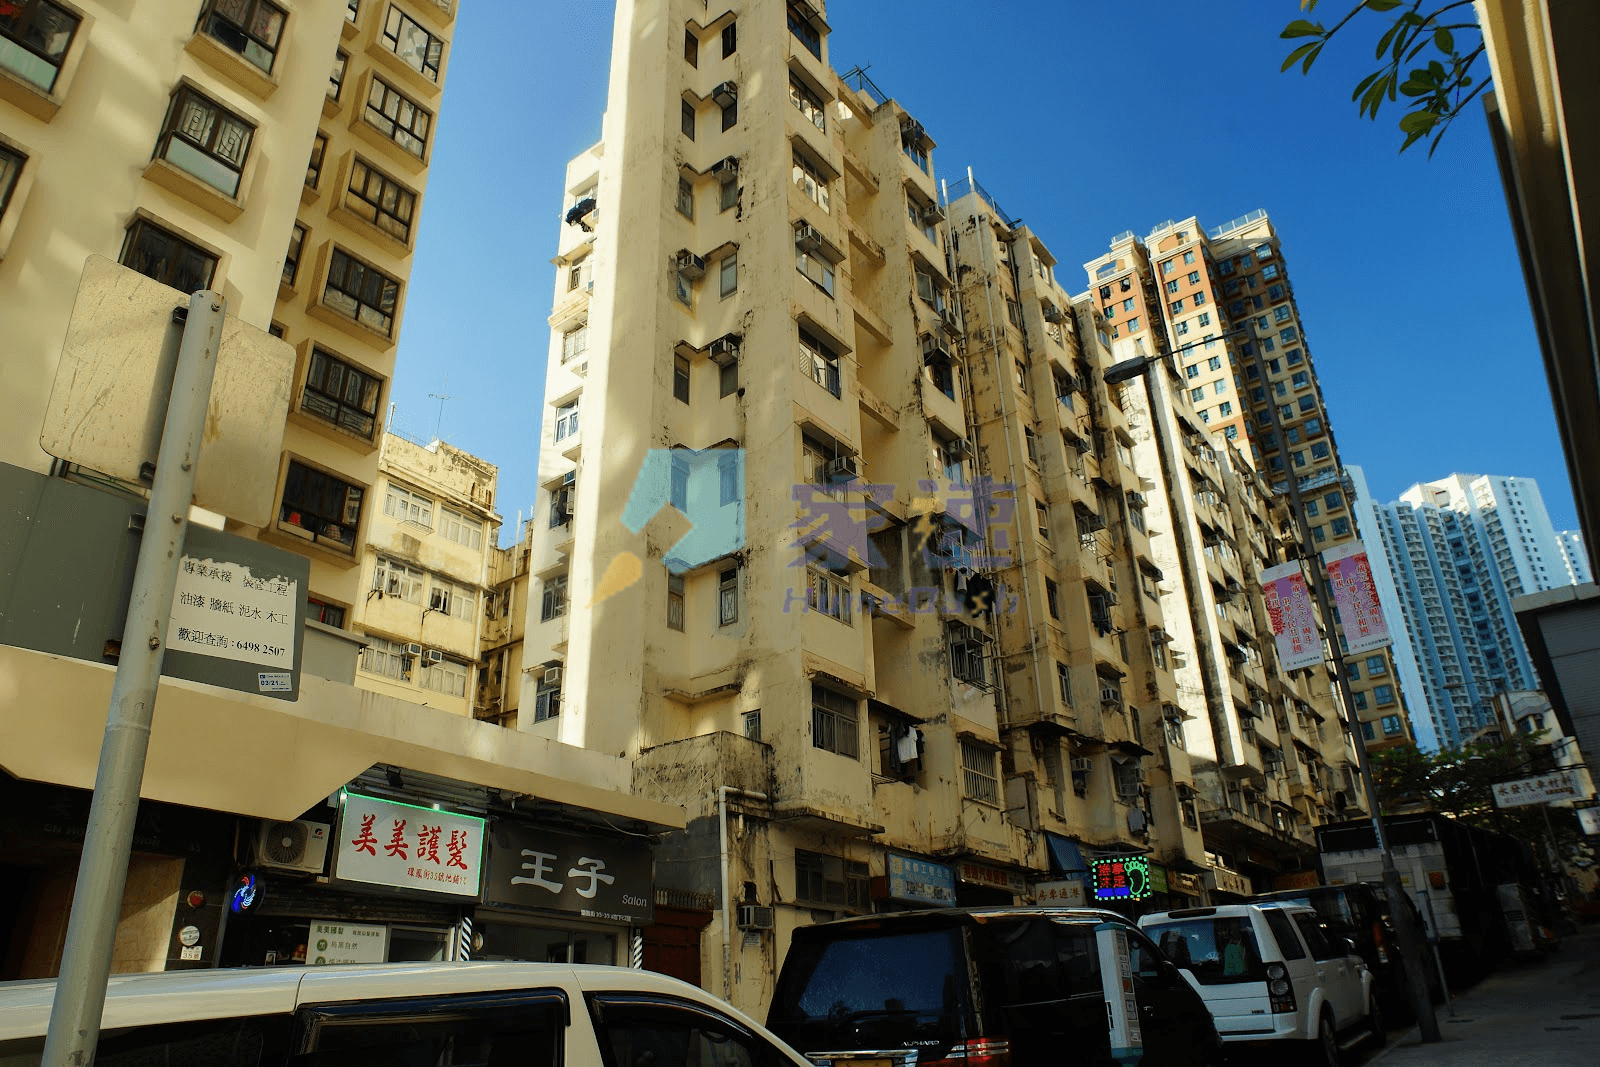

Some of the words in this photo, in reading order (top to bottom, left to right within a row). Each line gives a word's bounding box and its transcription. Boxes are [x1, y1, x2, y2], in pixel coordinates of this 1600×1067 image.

[183, 560, 232, 583] 專業承接
[180, 591, 205, 608] 油漆
[239, 604, 261, 620] 泥水
[266, 610, 288, 625] 木工
[236, 640, 260, 652] 6498
[263, 644, 285, 658] 2507
[352, 813, 468, 870] 美美護髮
[510, 848, 615, 899] 王子
[622, 894, 647, 908] Salon
[901, 1039, 940, 1047] ALPHARD
